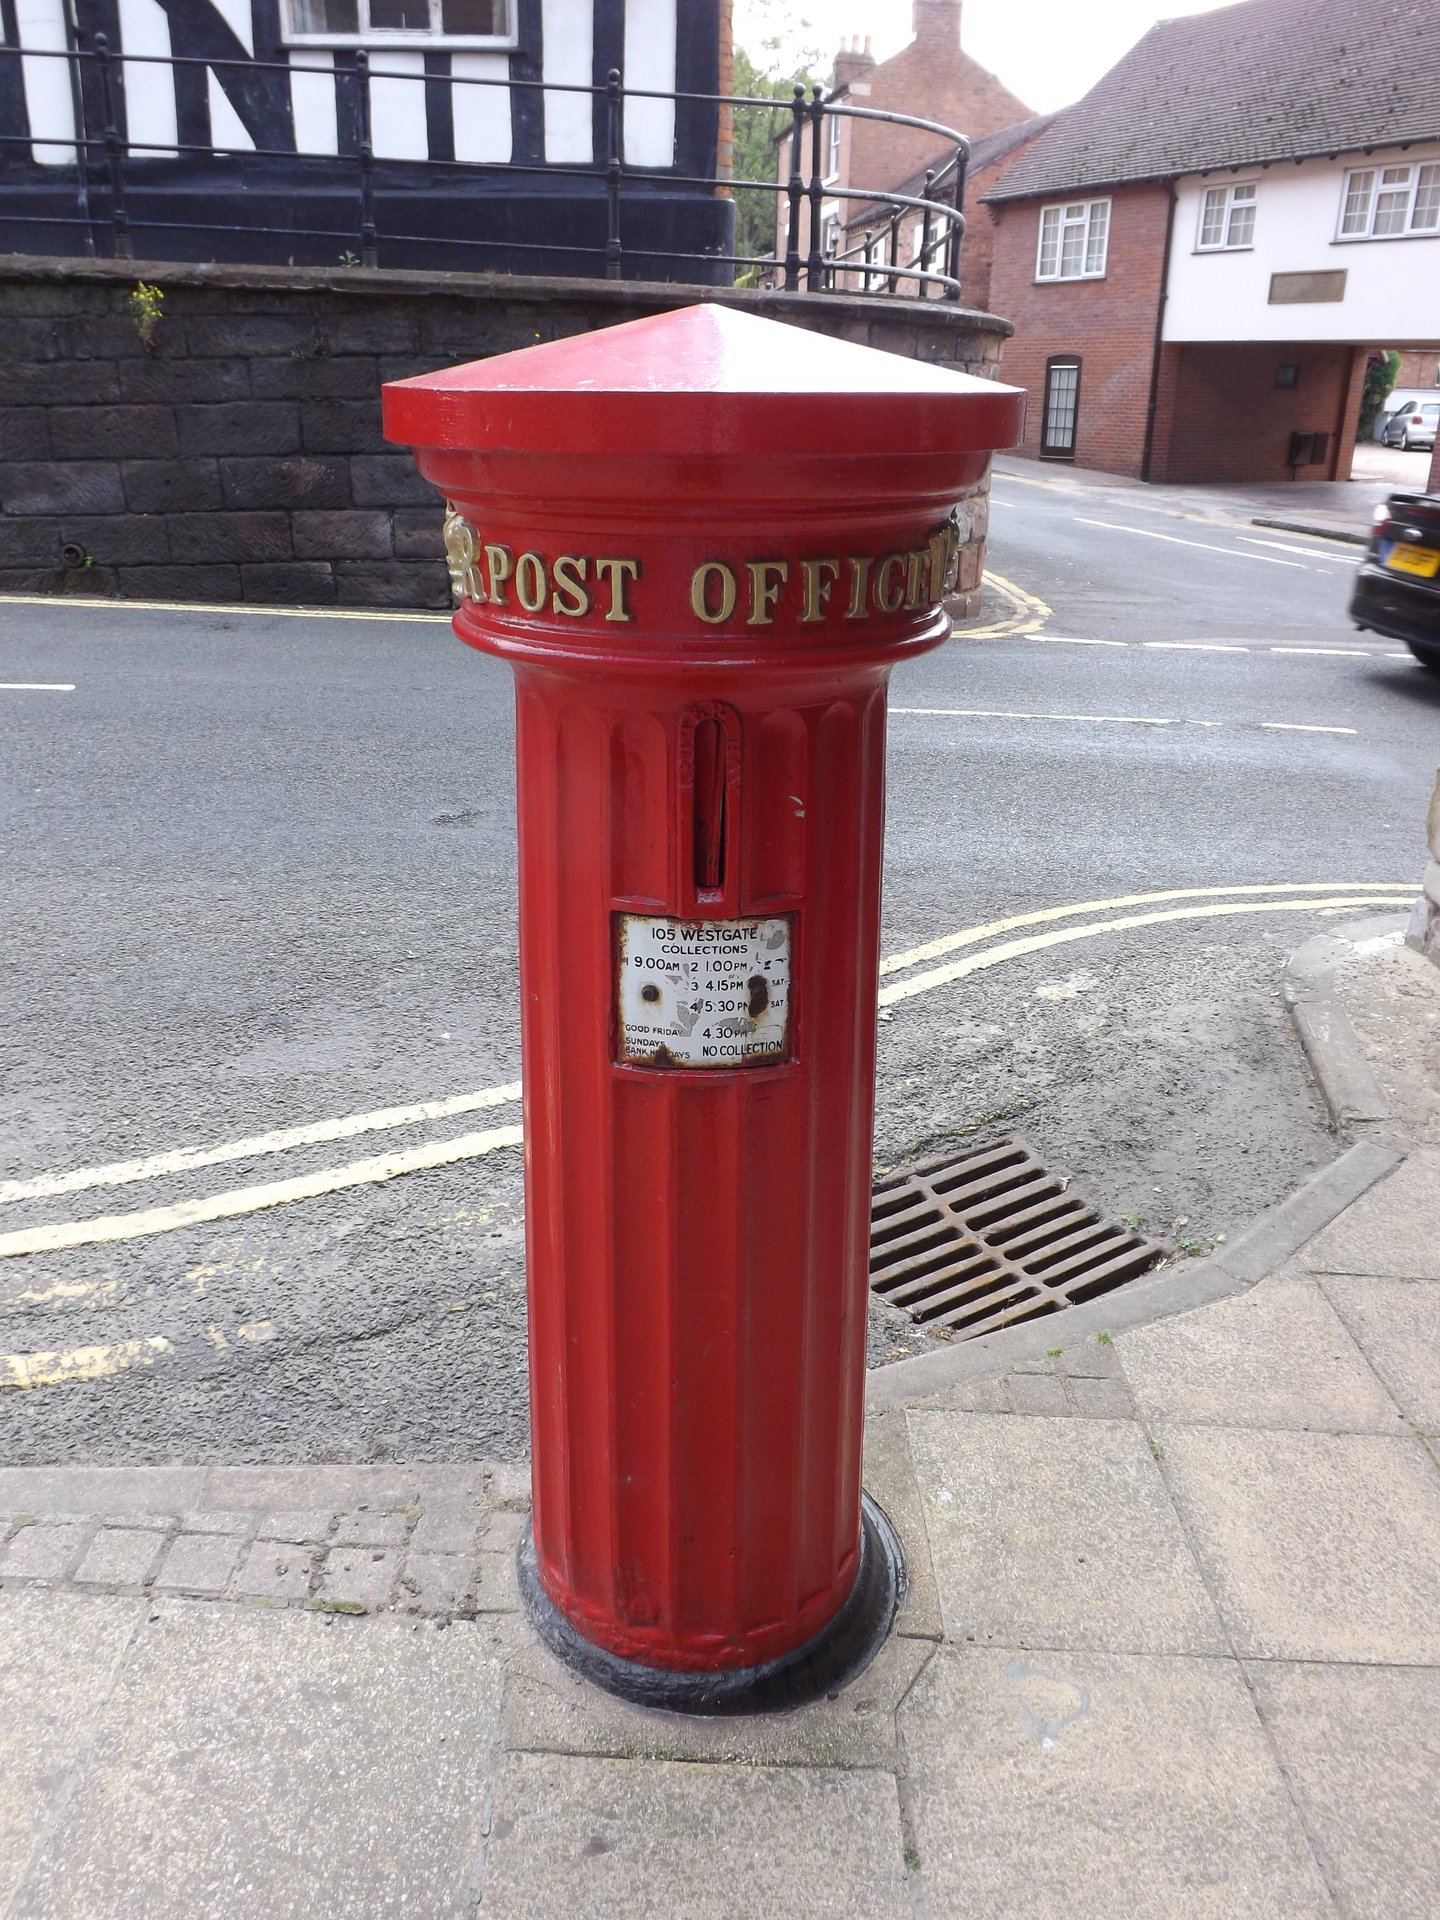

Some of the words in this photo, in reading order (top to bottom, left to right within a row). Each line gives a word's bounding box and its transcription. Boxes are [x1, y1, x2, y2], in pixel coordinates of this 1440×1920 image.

[484, 543, 639, 621] POST
[690, 549, 931, 624] OFFICE
[652, 927, 675, 941] 105
[681, 927, 757, 942] WESTGATE
[661, 944, 748, 955] COLLECTIONS
[634, 956, 680, 971] 9.00AM
[690, 962, 699, 972] 2
[705, 960, 748, 972] 1.00PM
[690, 982, 699, 991] 3
[705, 980, 744, 991] 4.15PM
[771, 978, 785, 986] SAT
[770, 999, 784, 1008] SAT
[625, 1024, 650, 1034] GOOD
[652, 1027, 684, 1037] FRIDAY
[702, 1027, 748, 1039] 4.30PM
[625, 1046, 648, 1056] BANK
[702, 1046, 718, 1057] NO
[719, 1040, 783, 1056] COLLECTION
